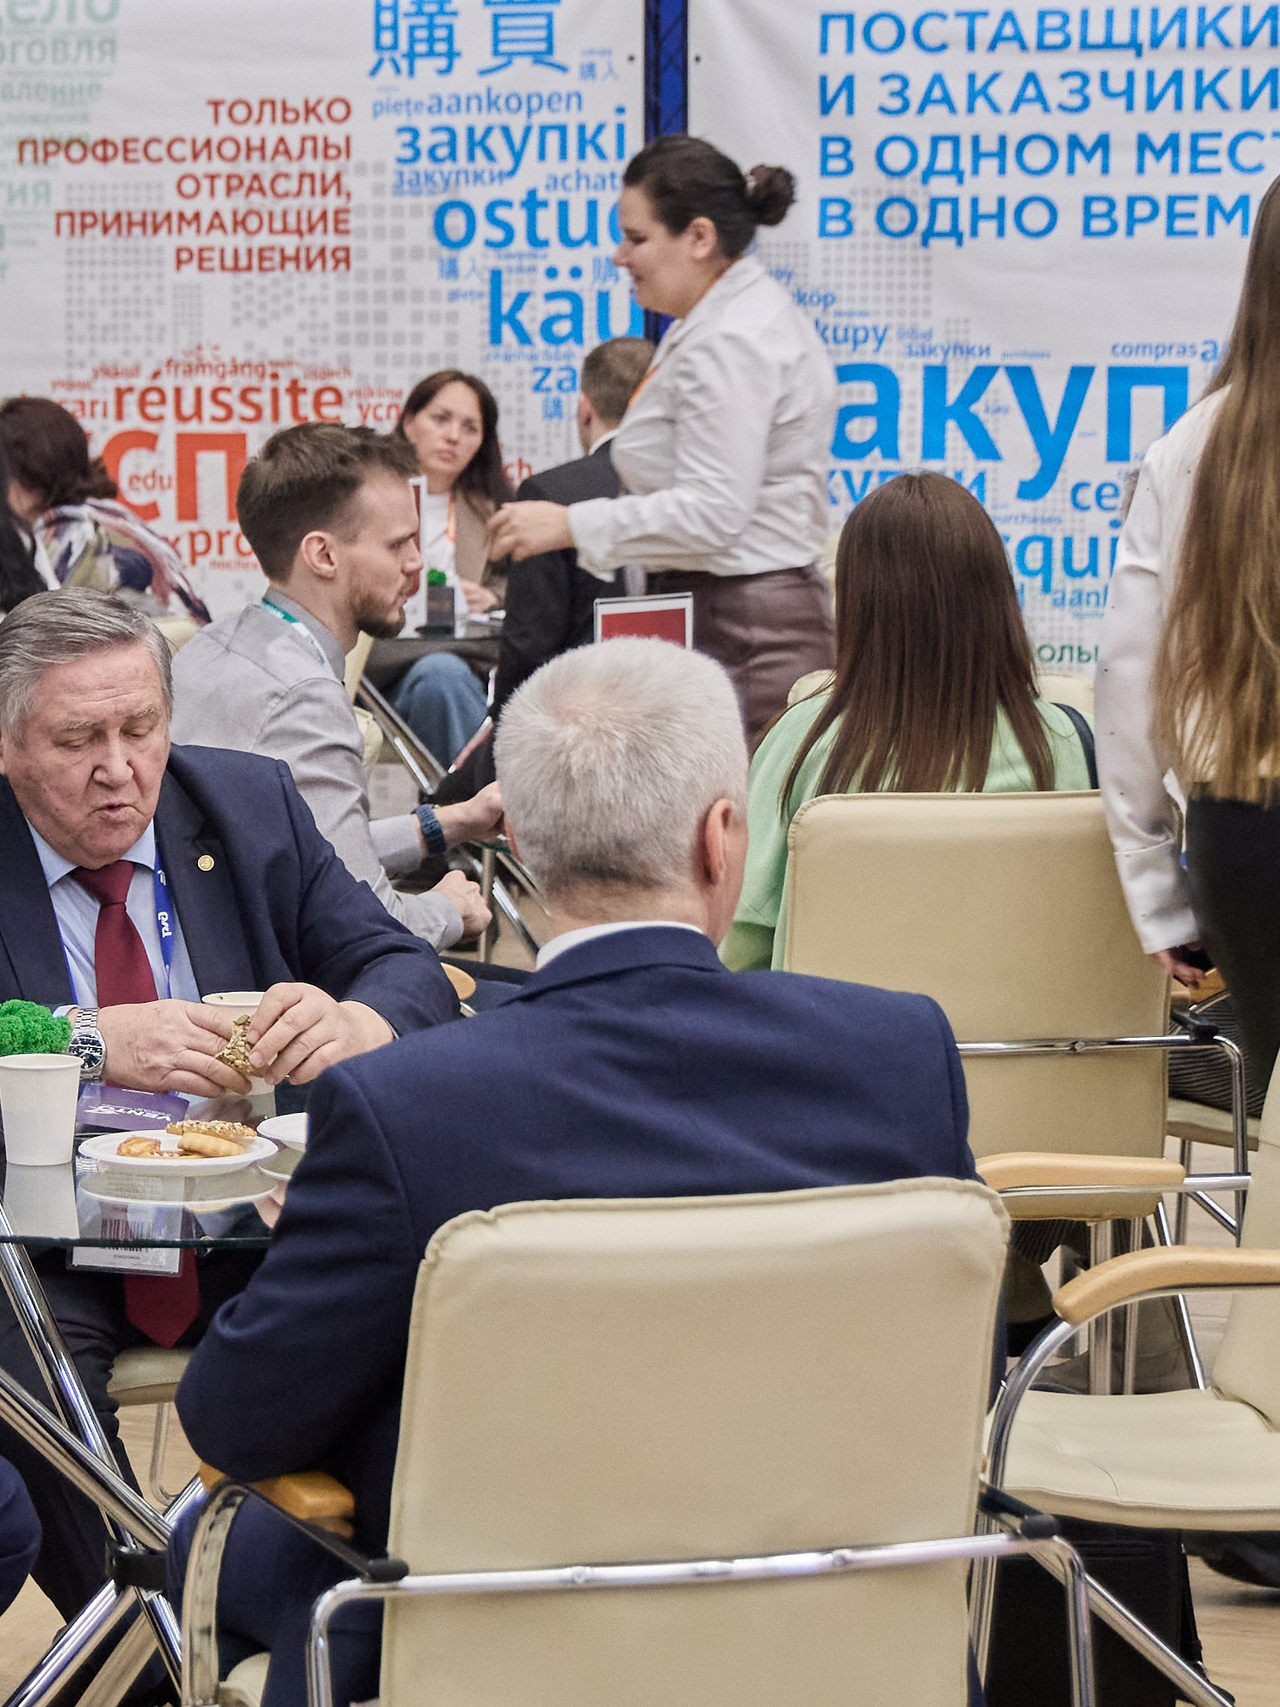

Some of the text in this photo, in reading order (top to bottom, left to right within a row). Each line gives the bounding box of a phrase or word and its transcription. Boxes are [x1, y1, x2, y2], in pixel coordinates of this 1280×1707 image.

[819, 5, 1279, 58] ПОСТАВЩИКИ
[426, 85, 584, 123] aankopen
[819, 67, 1280, 117] И ЗАКАЗЧИКИ
[207, 97, 352, 126] ТОЛЬКО
[17, 134, 352, 167] ПРОФЕССИОНАЛЫ
[395, 106, 626, 178] закупкі
[820, 134, 855, 177] В
[875, 132, 1111, 186] ОДНОМ
[176, 171, 352, 203] ОТРАСЛИ,
[54, 207, 352, 240] ПРИНИМАЮЩИЕ
[819, 194, 1251, 248] В ОДНО ВРЕМ
[175, 245, 352, 272] РЕШЕНИЯ
[1110, 338, 1198, 362] compras
[166, 354, 268, 382] framgång
[114, 367, 344, 424] réussite
[128, 468, 173, 491] edu
